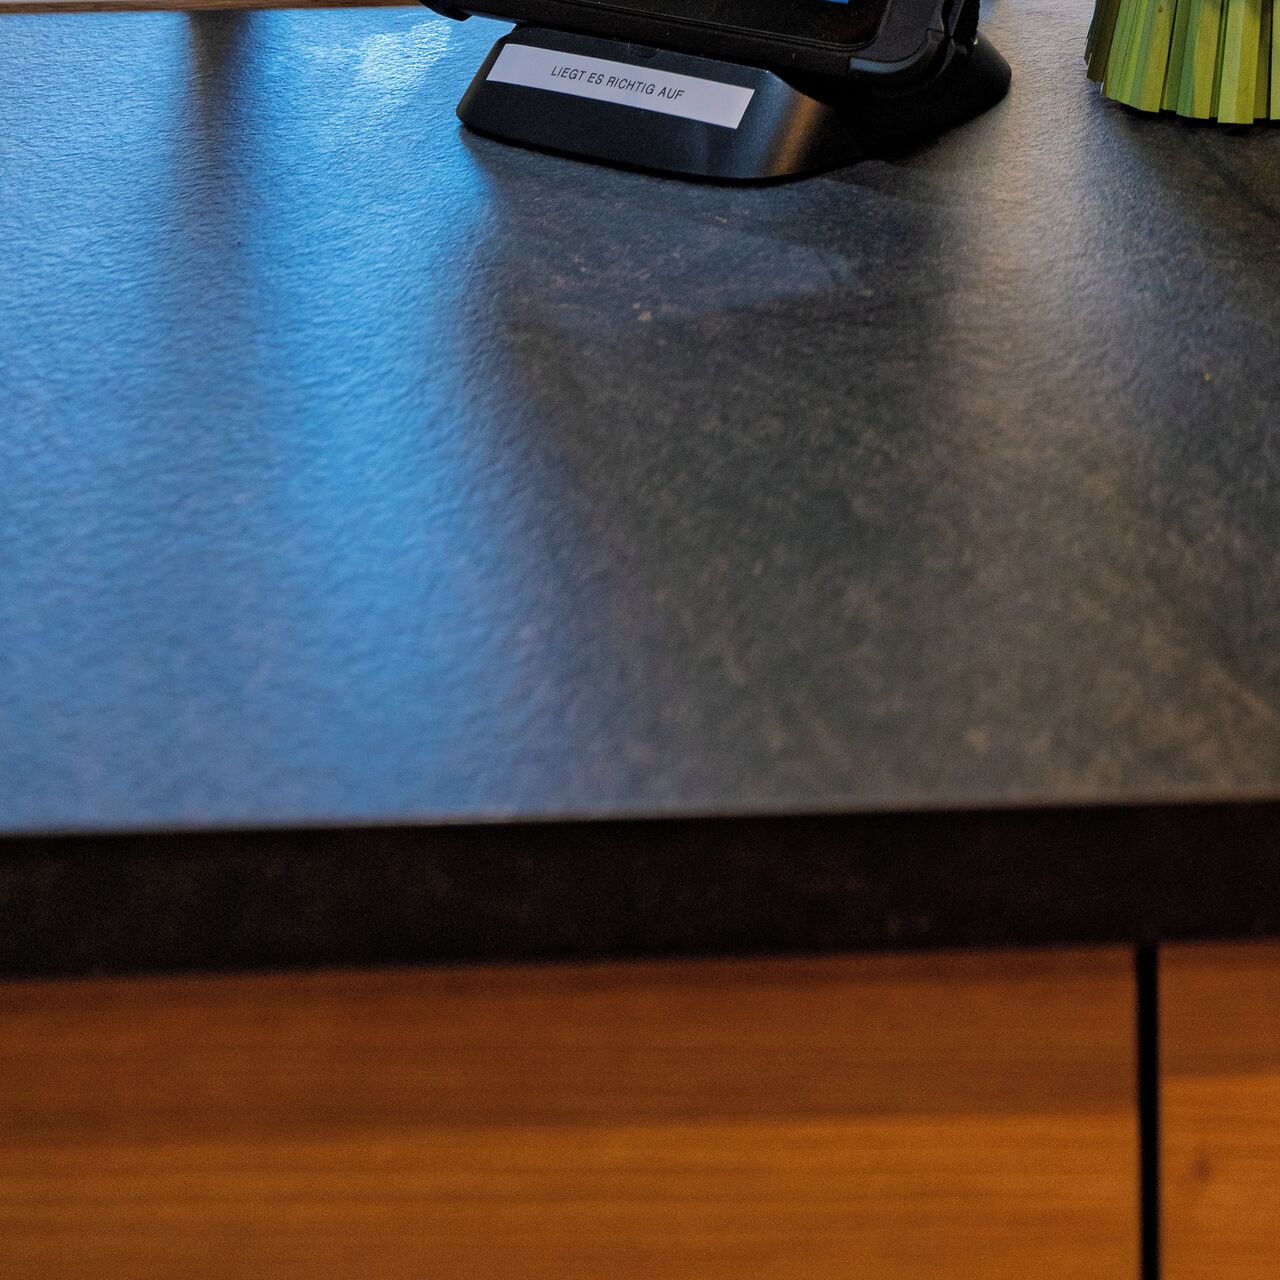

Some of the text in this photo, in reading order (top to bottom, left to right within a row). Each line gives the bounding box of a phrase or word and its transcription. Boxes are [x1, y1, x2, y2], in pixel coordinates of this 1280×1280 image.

[550, 65, 686, 101] LIEGT ES RICHTIG AUF
